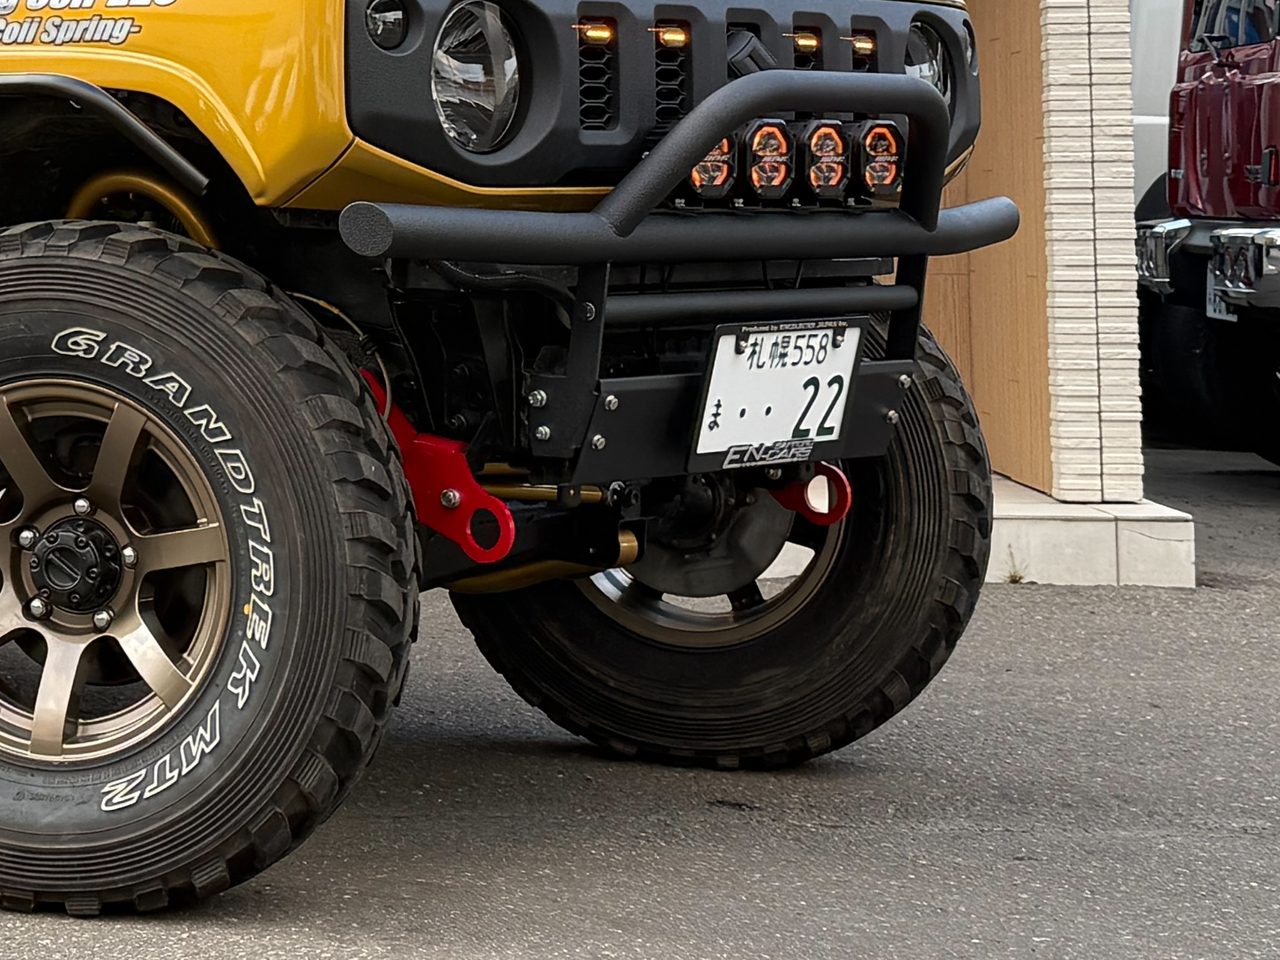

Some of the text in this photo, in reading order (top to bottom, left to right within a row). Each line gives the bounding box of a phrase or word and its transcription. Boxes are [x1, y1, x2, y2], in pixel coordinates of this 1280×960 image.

[708, 399, 722, 431] ま
[51, 326, 275, 710] GRANDTREK
[100, 695, 222, 812] MT2
